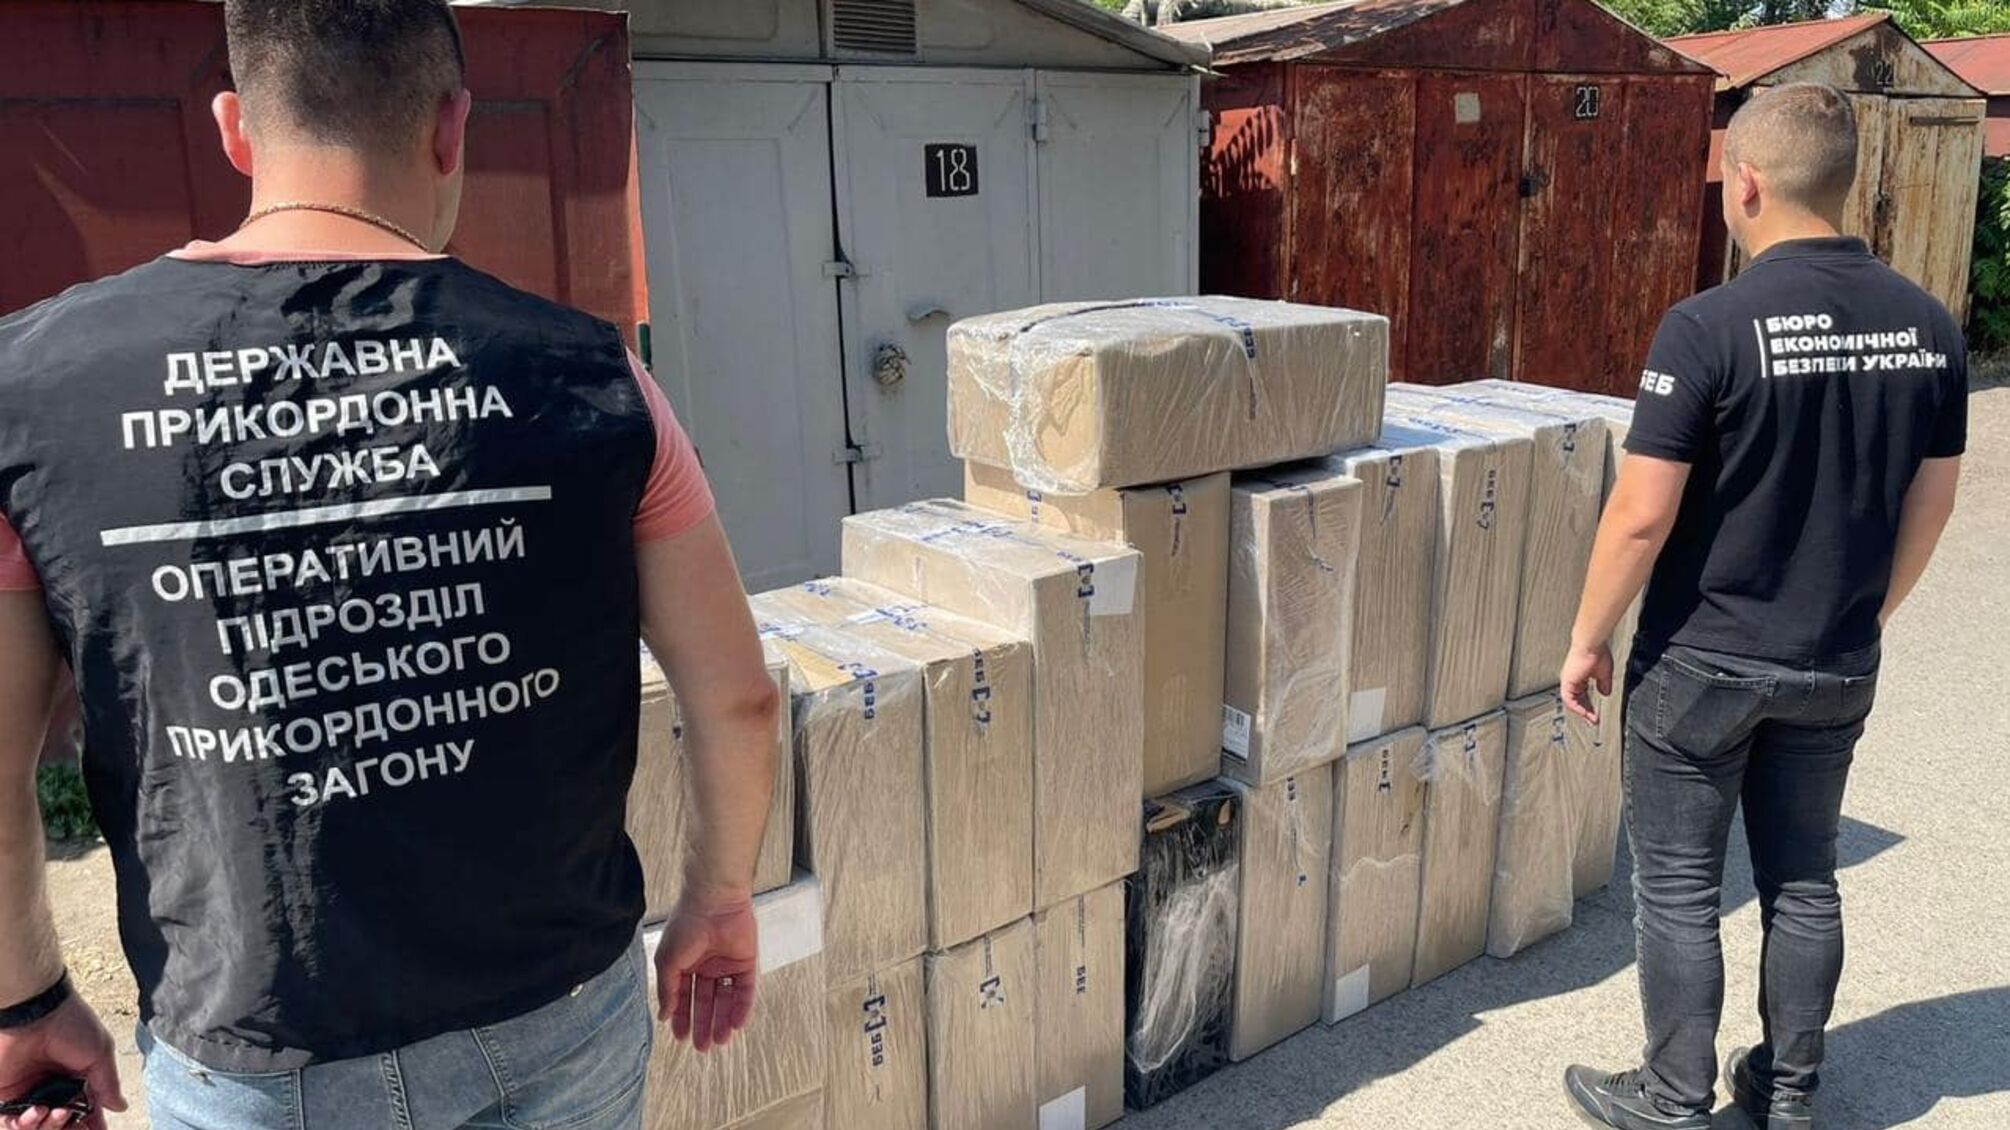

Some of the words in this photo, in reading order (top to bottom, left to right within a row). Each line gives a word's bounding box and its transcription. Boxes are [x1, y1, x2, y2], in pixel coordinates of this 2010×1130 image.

[1575, 86, 1599, 118] 20
[936, 148, 971, 192] 18
[1766, 313, 1833, 333] БЮРО
[163, 336, 461, 396] ДЕРЖАВНА
[121, 384, 513, 450] ПРИКОРДОННА
[219, 444, 441, 502] СЛУЖБА
[151, 517, 526, 603] ОПЕРАТИВНИЙ
[216, 583, 486, 655] ПІДРОЗДІЛ
[208, 631, 512, 713] ОДЕСЬКОГО
[165, 667, 561, 764] ПРИКОРДОННОГО
[287, 740, 475, 807] ЗАГОНУ
